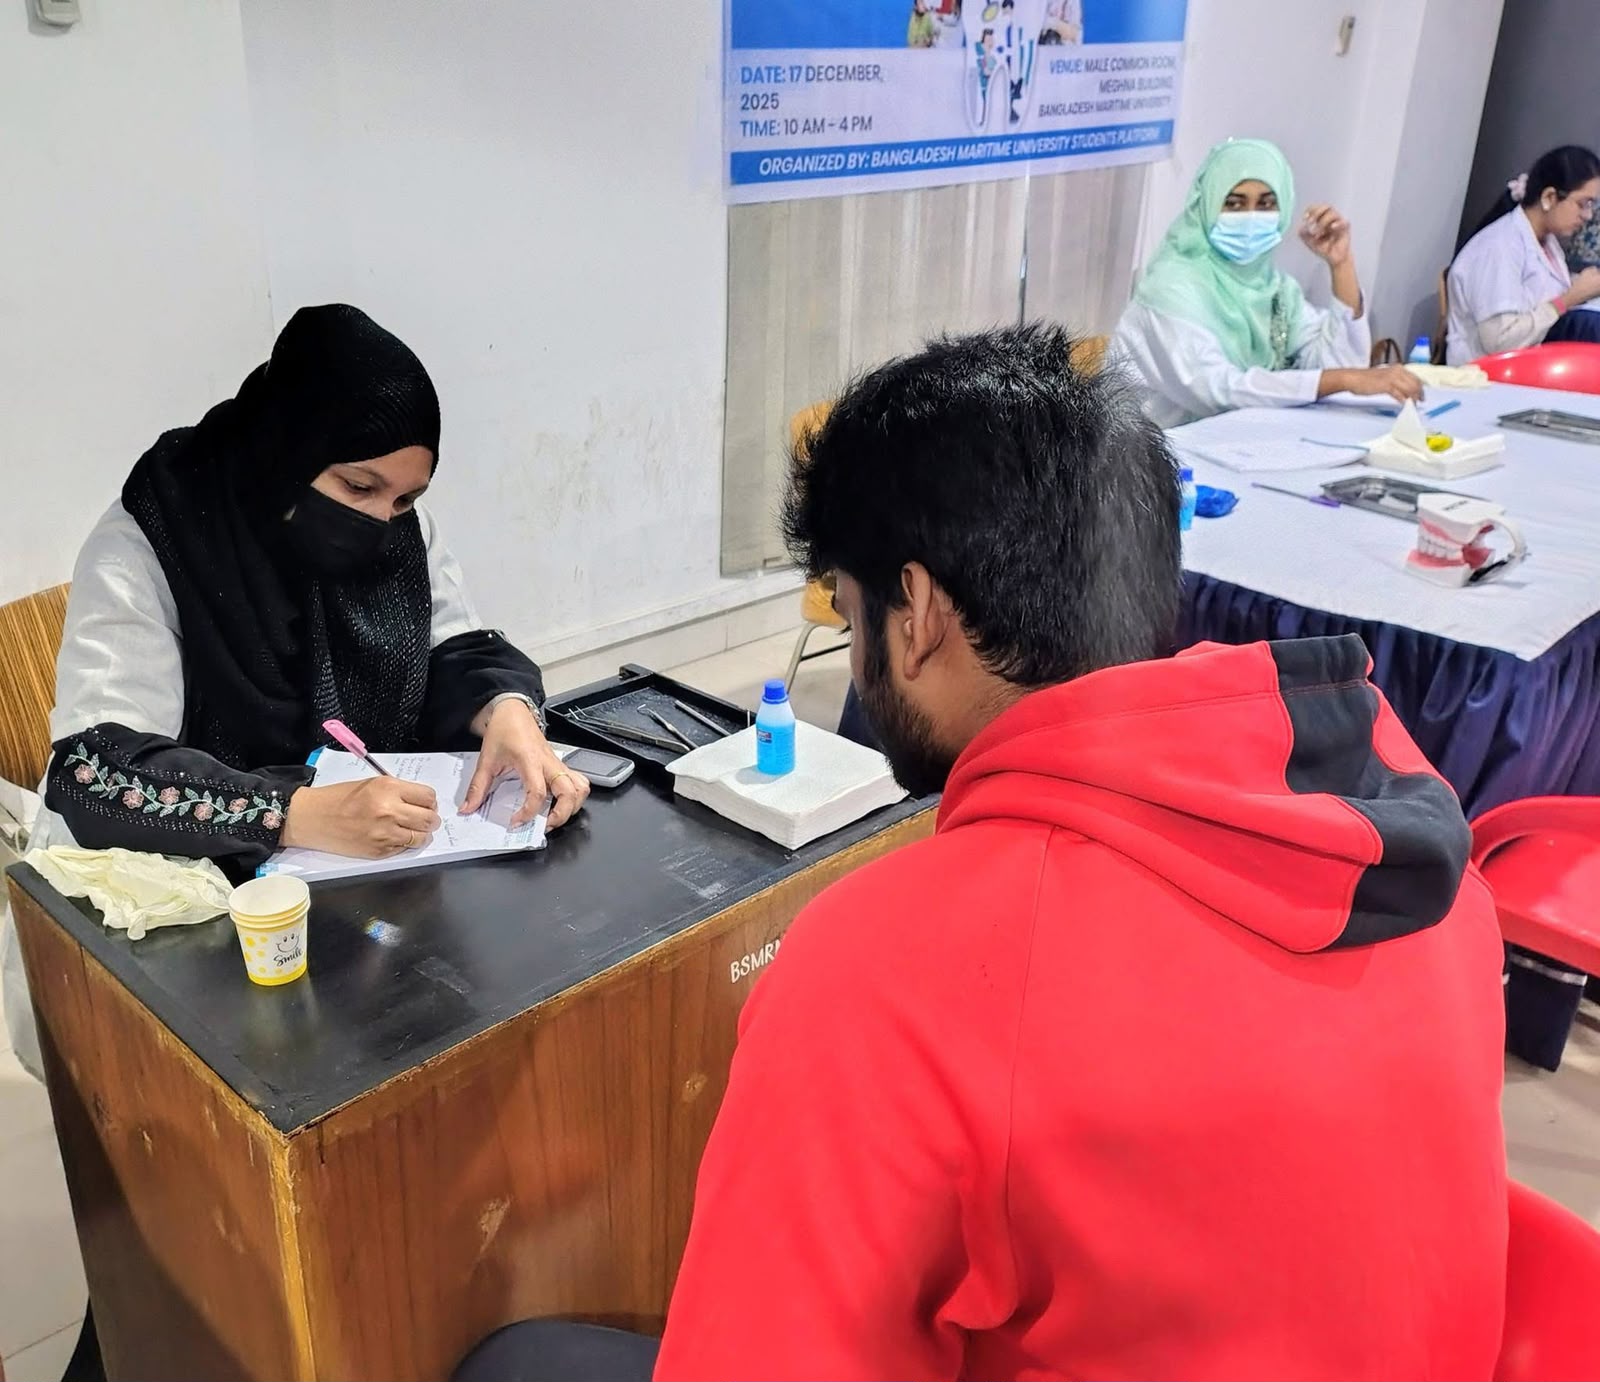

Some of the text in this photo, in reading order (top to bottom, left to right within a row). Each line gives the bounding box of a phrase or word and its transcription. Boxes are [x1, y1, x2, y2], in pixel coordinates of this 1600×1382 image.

[740, 64, 883, 84] DATE: 17 DECEMBER,
[1084, 58, 1109, 73] MALE
[741, 93, 779, 111] 2025
[1038, 101, 1094, 118] BANGLADESH
[740, 119, 780, 137] TIME:
[784, 118, 798, 136] 10
[802, 117, 825, 134] AM
[839, 116, 848, 132] 4
[851, 115, 873, 132] PM
[759, 152, 845, 177] ORGANIZED
[847, 151, 869, 169] BY:
[871, 144, 955, 168] BANGLADESH
[957, 139, 1012, 161] MARITIME
[1012, 135, 1071, 156] UNIVERSITY
[273, 946, 303, 967] Smile
